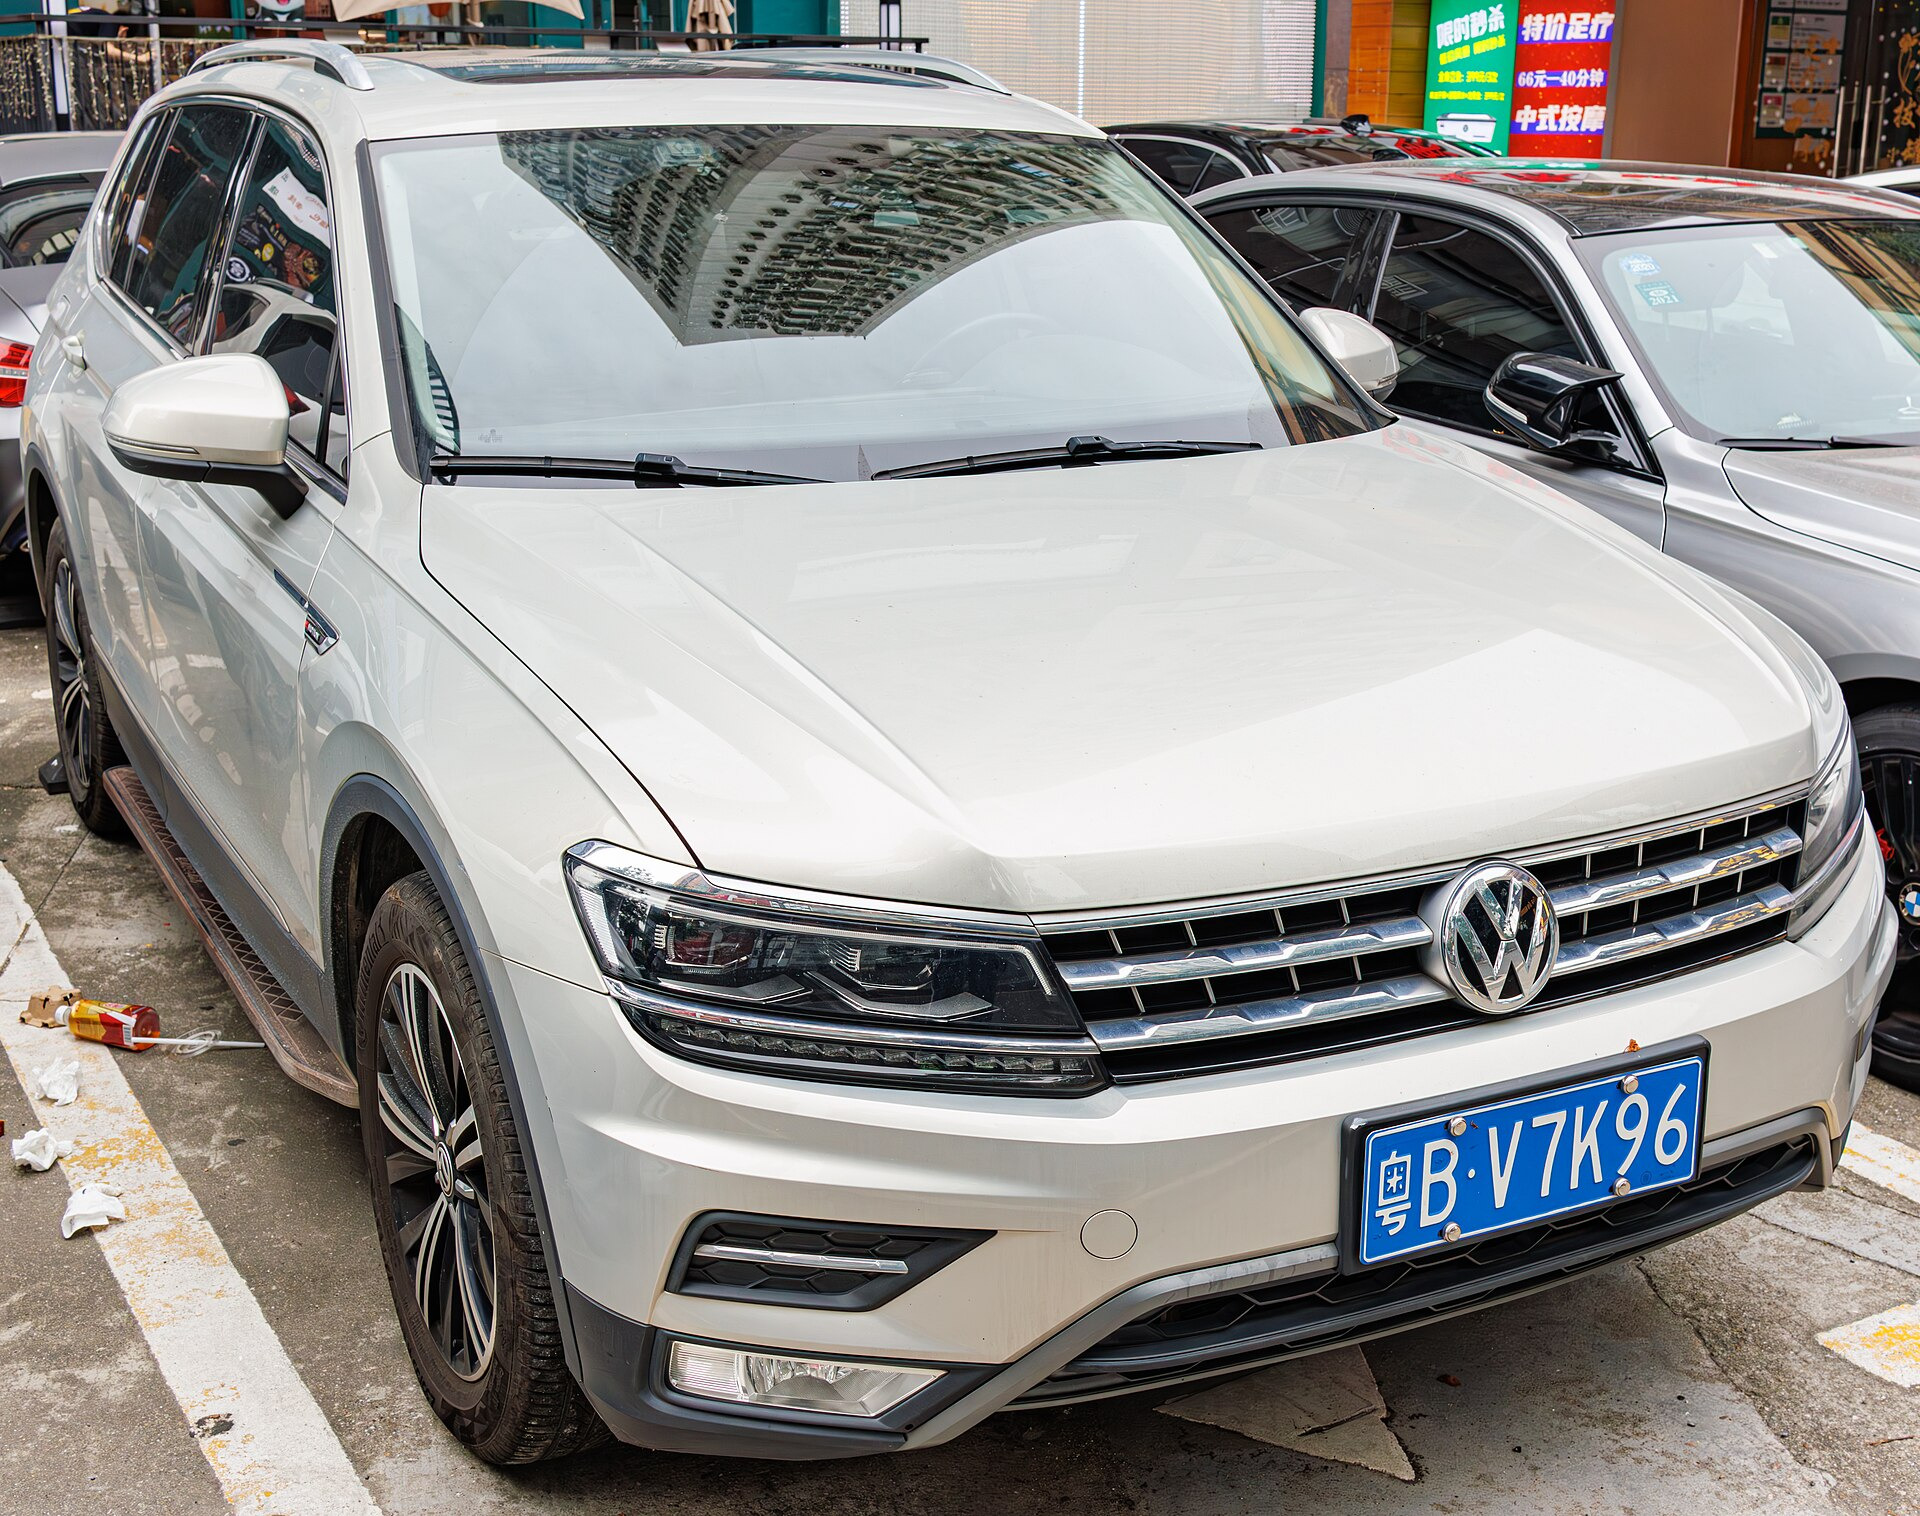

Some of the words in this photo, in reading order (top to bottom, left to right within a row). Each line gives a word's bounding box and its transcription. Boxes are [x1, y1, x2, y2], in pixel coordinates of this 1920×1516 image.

[1436, 3, 1505, 49] 限时秒杀
[1521, 12, 1615, 42] 特价足疗
[1515, 104, 1607, 132] 中式按摩
